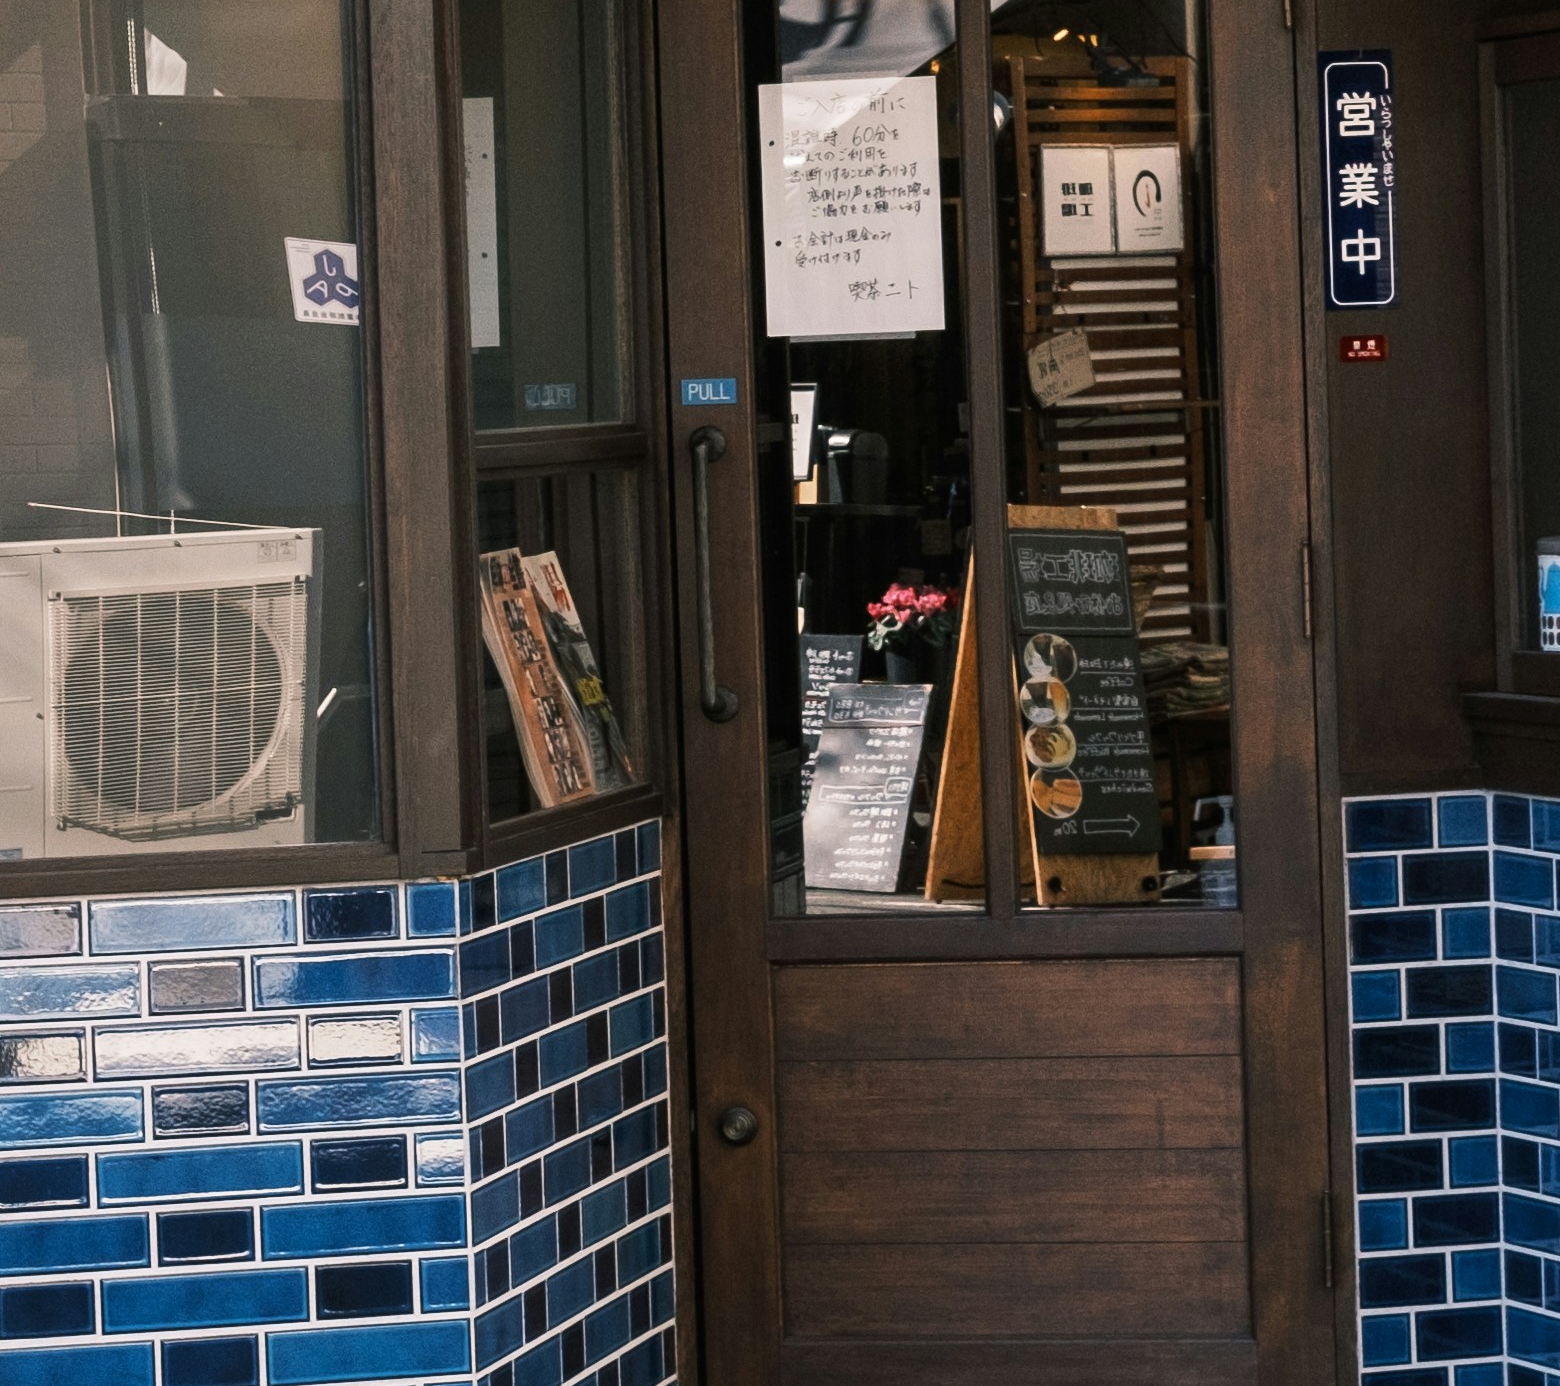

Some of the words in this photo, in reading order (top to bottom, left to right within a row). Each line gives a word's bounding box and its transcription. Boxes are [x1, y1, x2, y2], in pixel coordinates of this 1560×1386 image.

[785, 146, 888, 163] えてのご利用を
[1380, 94, 1396, 188] いらっしゃいませ
[1337, 91, 1382, 276] 営業中
[688, 382, 731, 401] PULL
